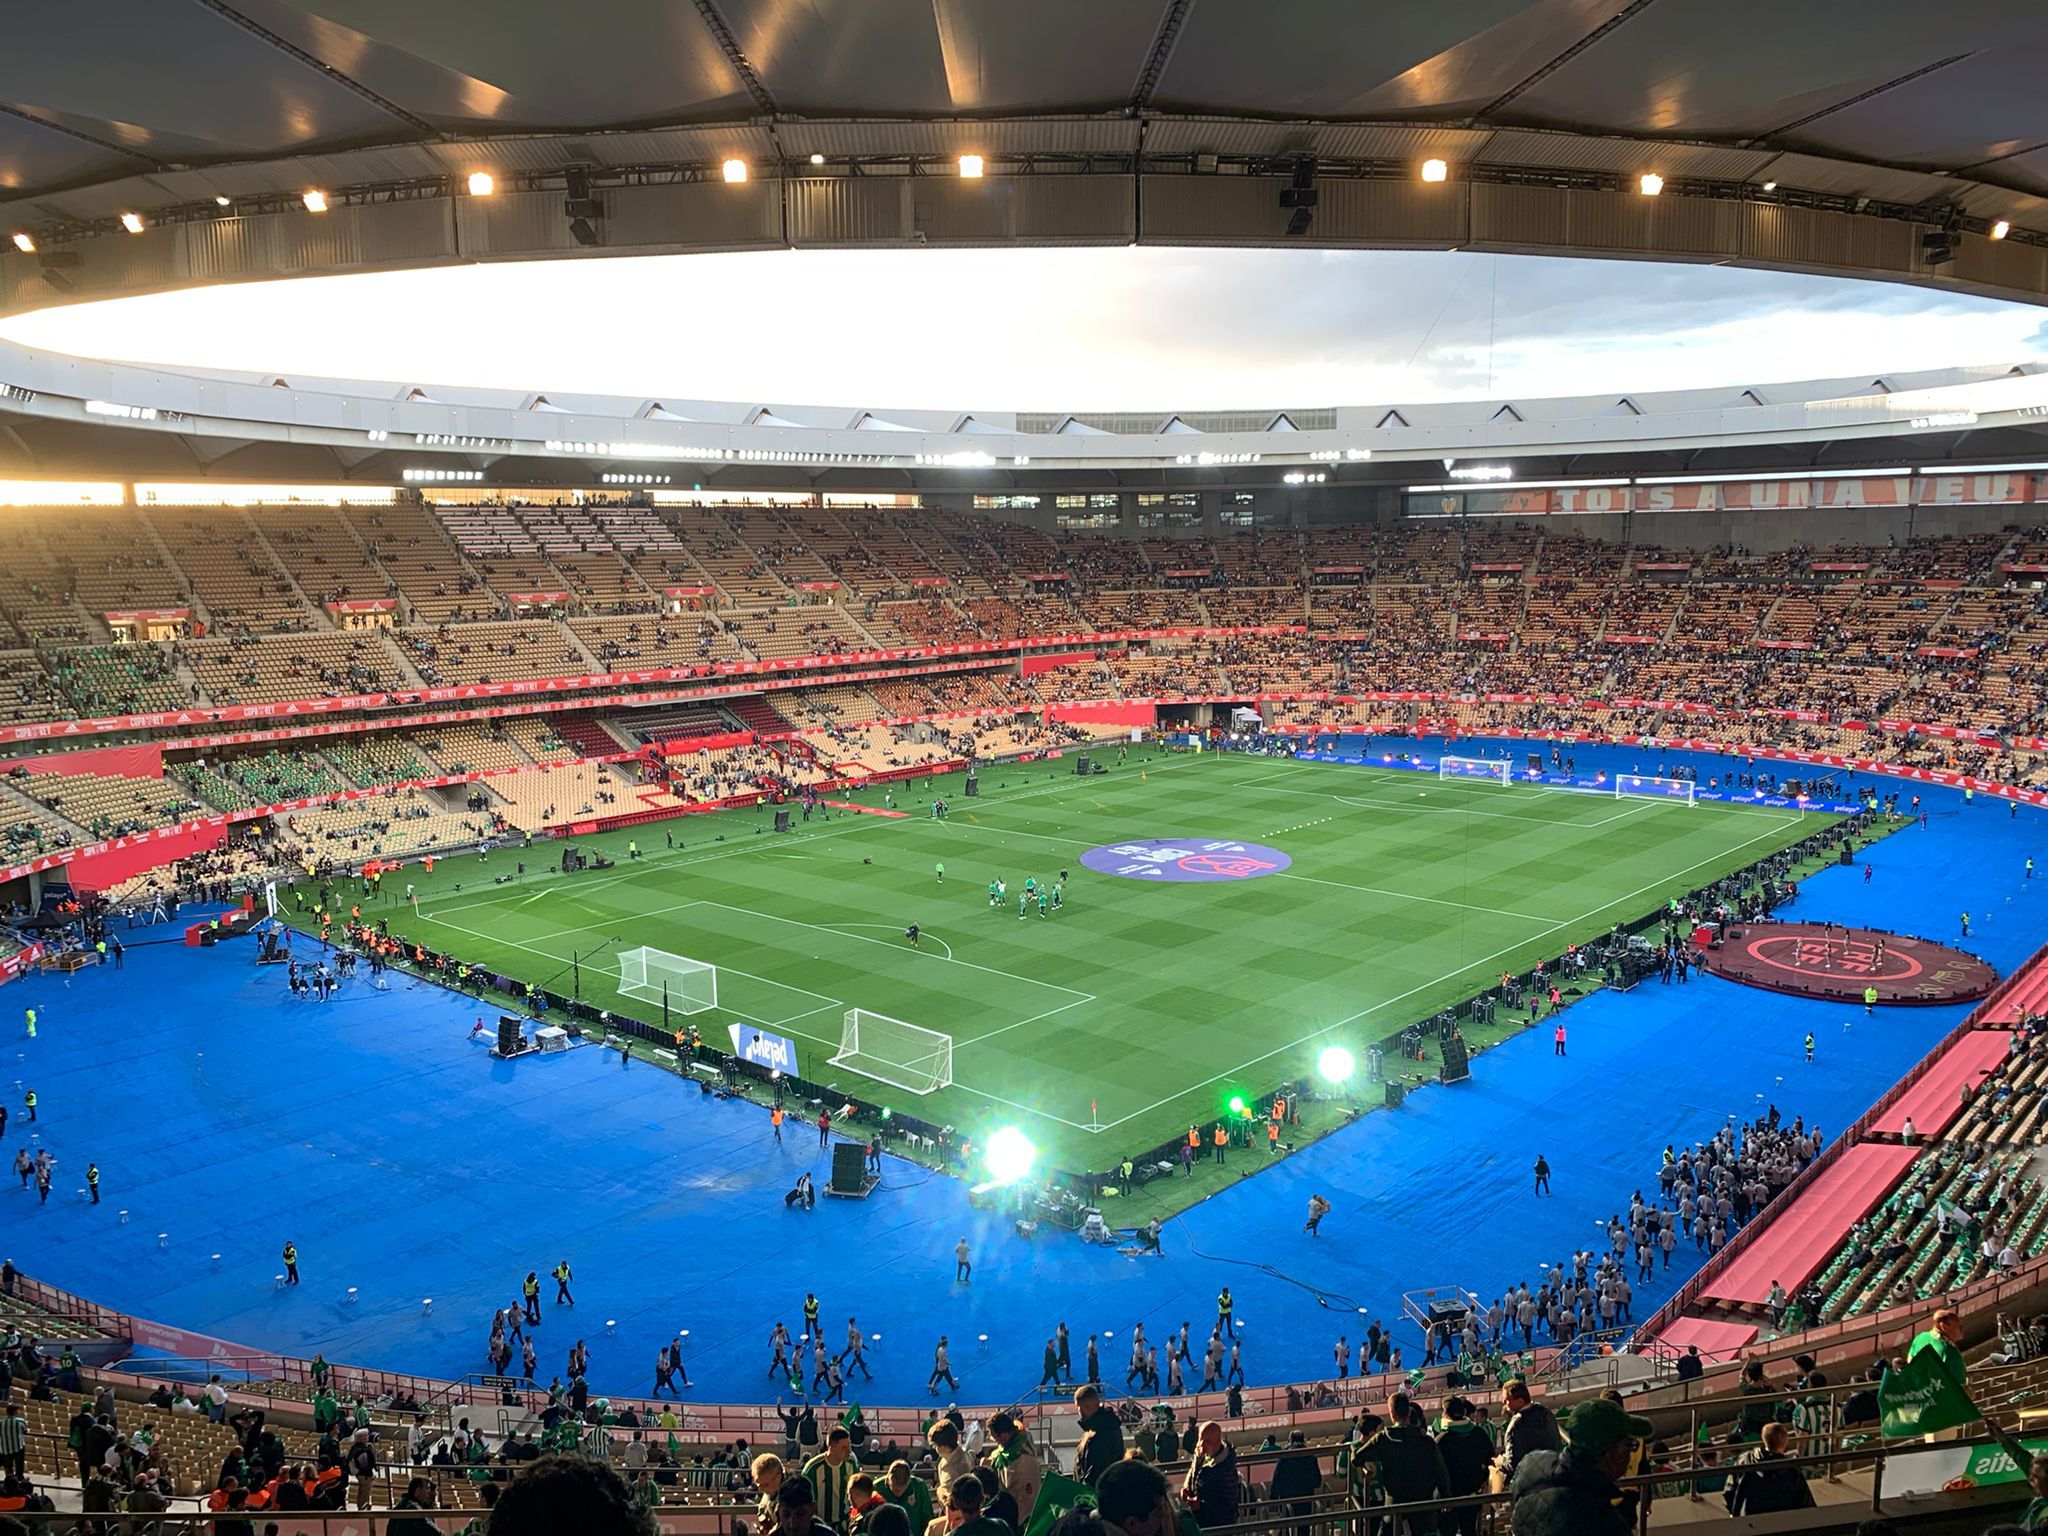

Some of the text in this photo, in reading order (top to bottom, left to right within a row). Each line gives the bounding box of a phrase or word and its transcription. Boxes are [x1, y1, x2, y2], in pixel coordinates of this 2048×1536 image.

[1556, 475, 2010, 512] TOTS A UNA VEU
[752, 1030, 788, 1069] pelayo
